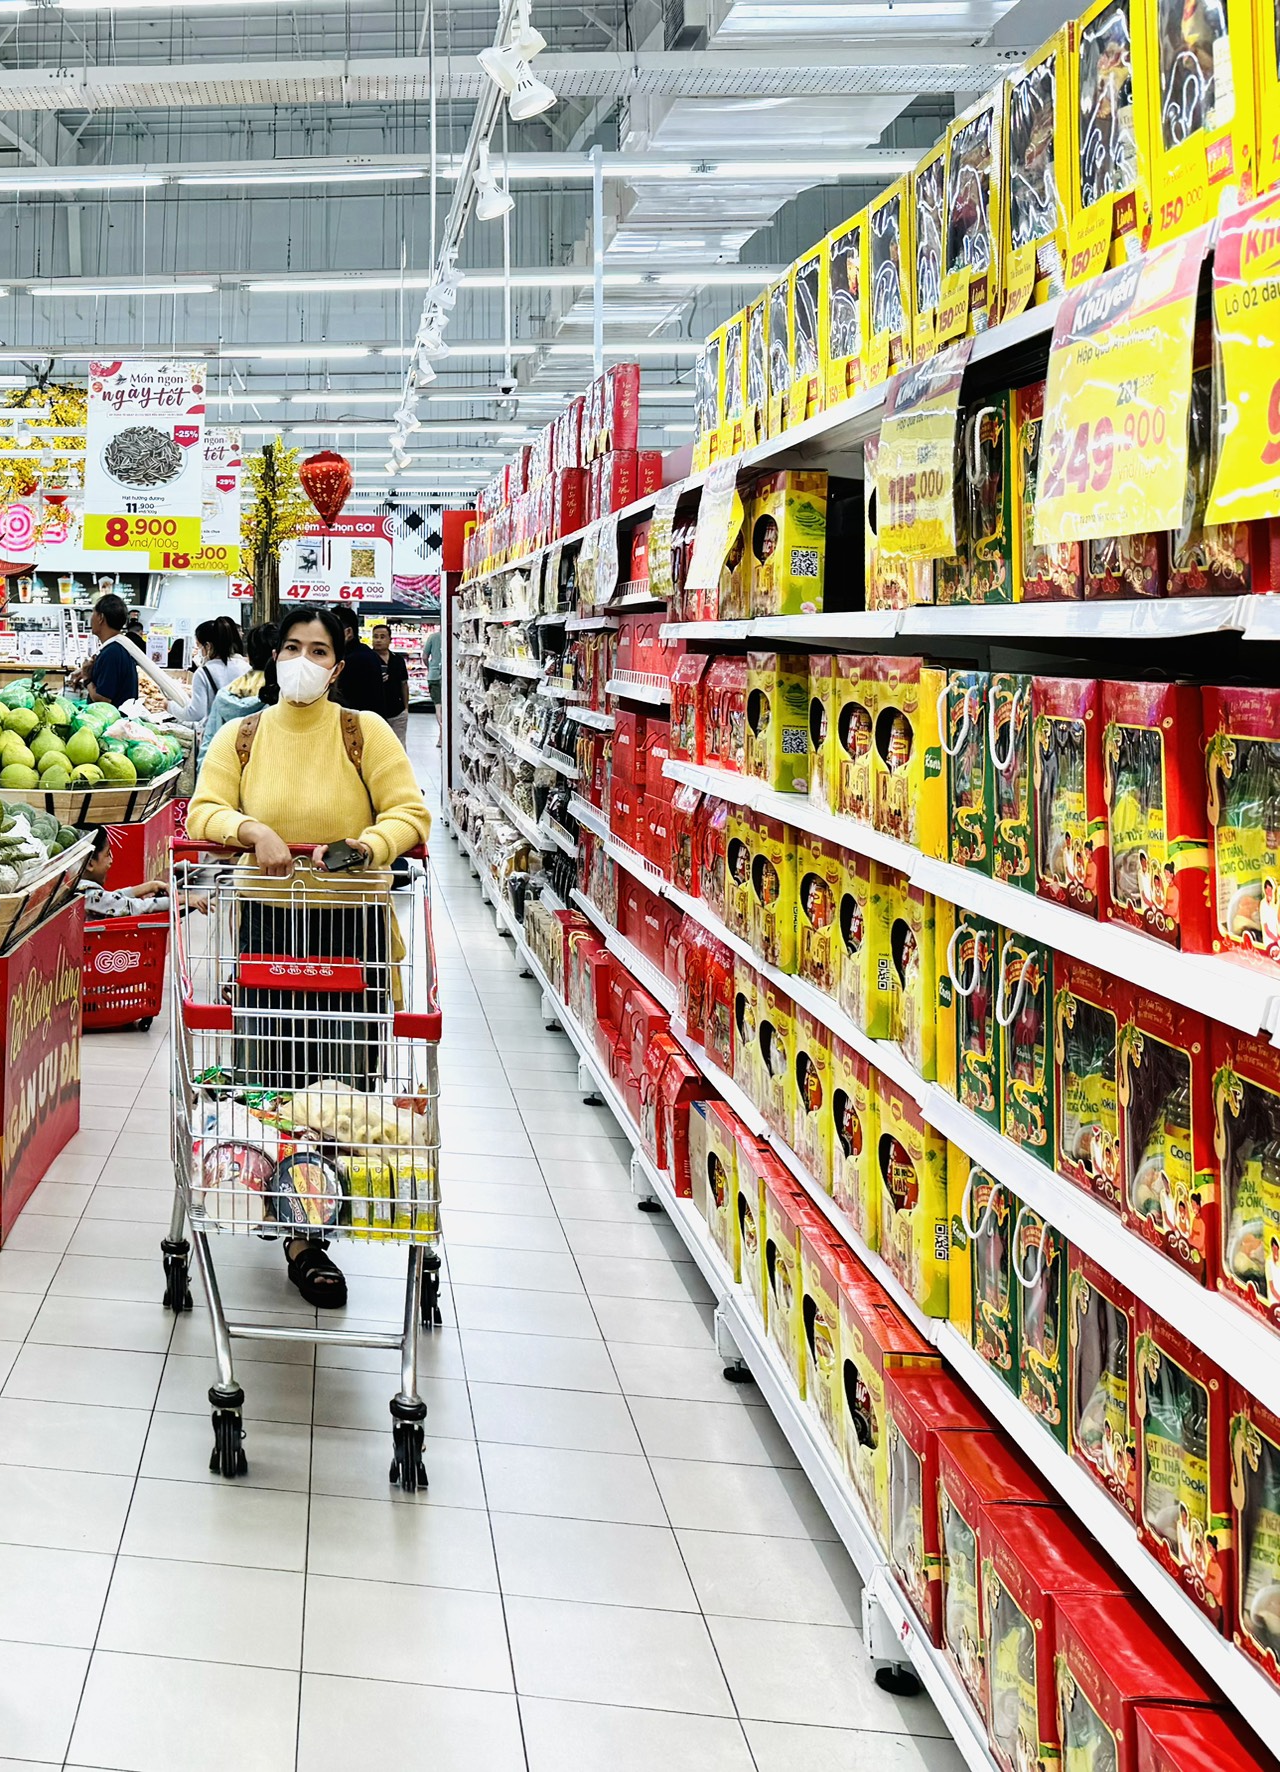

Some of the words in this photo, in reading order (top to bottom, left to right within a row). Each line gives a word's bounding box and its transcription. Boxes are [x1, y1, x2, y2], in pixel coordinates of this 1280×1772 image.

[1159, 186, 1203, 231] 150.000
[1070, 238, 1106, 278] 150.000
[1242, 288, 1258, 309] 02
[130, 373, 153, 383] Món
[158, 375, 184, 386] ngon
[102, 384, 151, 410] ngày
[153, 387, 190, 406] tết
[175, 430, 198, 438] -25%
[1043, 406, 1166, 498] 249.900
[105, 517, 177, 547] 8.900
[355, 523, 375, 532] GO!
[129, 538, 179, 550] vnd/100g
[287, 585, 330, 598] 47.000
[339, 586, 384, 599] 64.000
